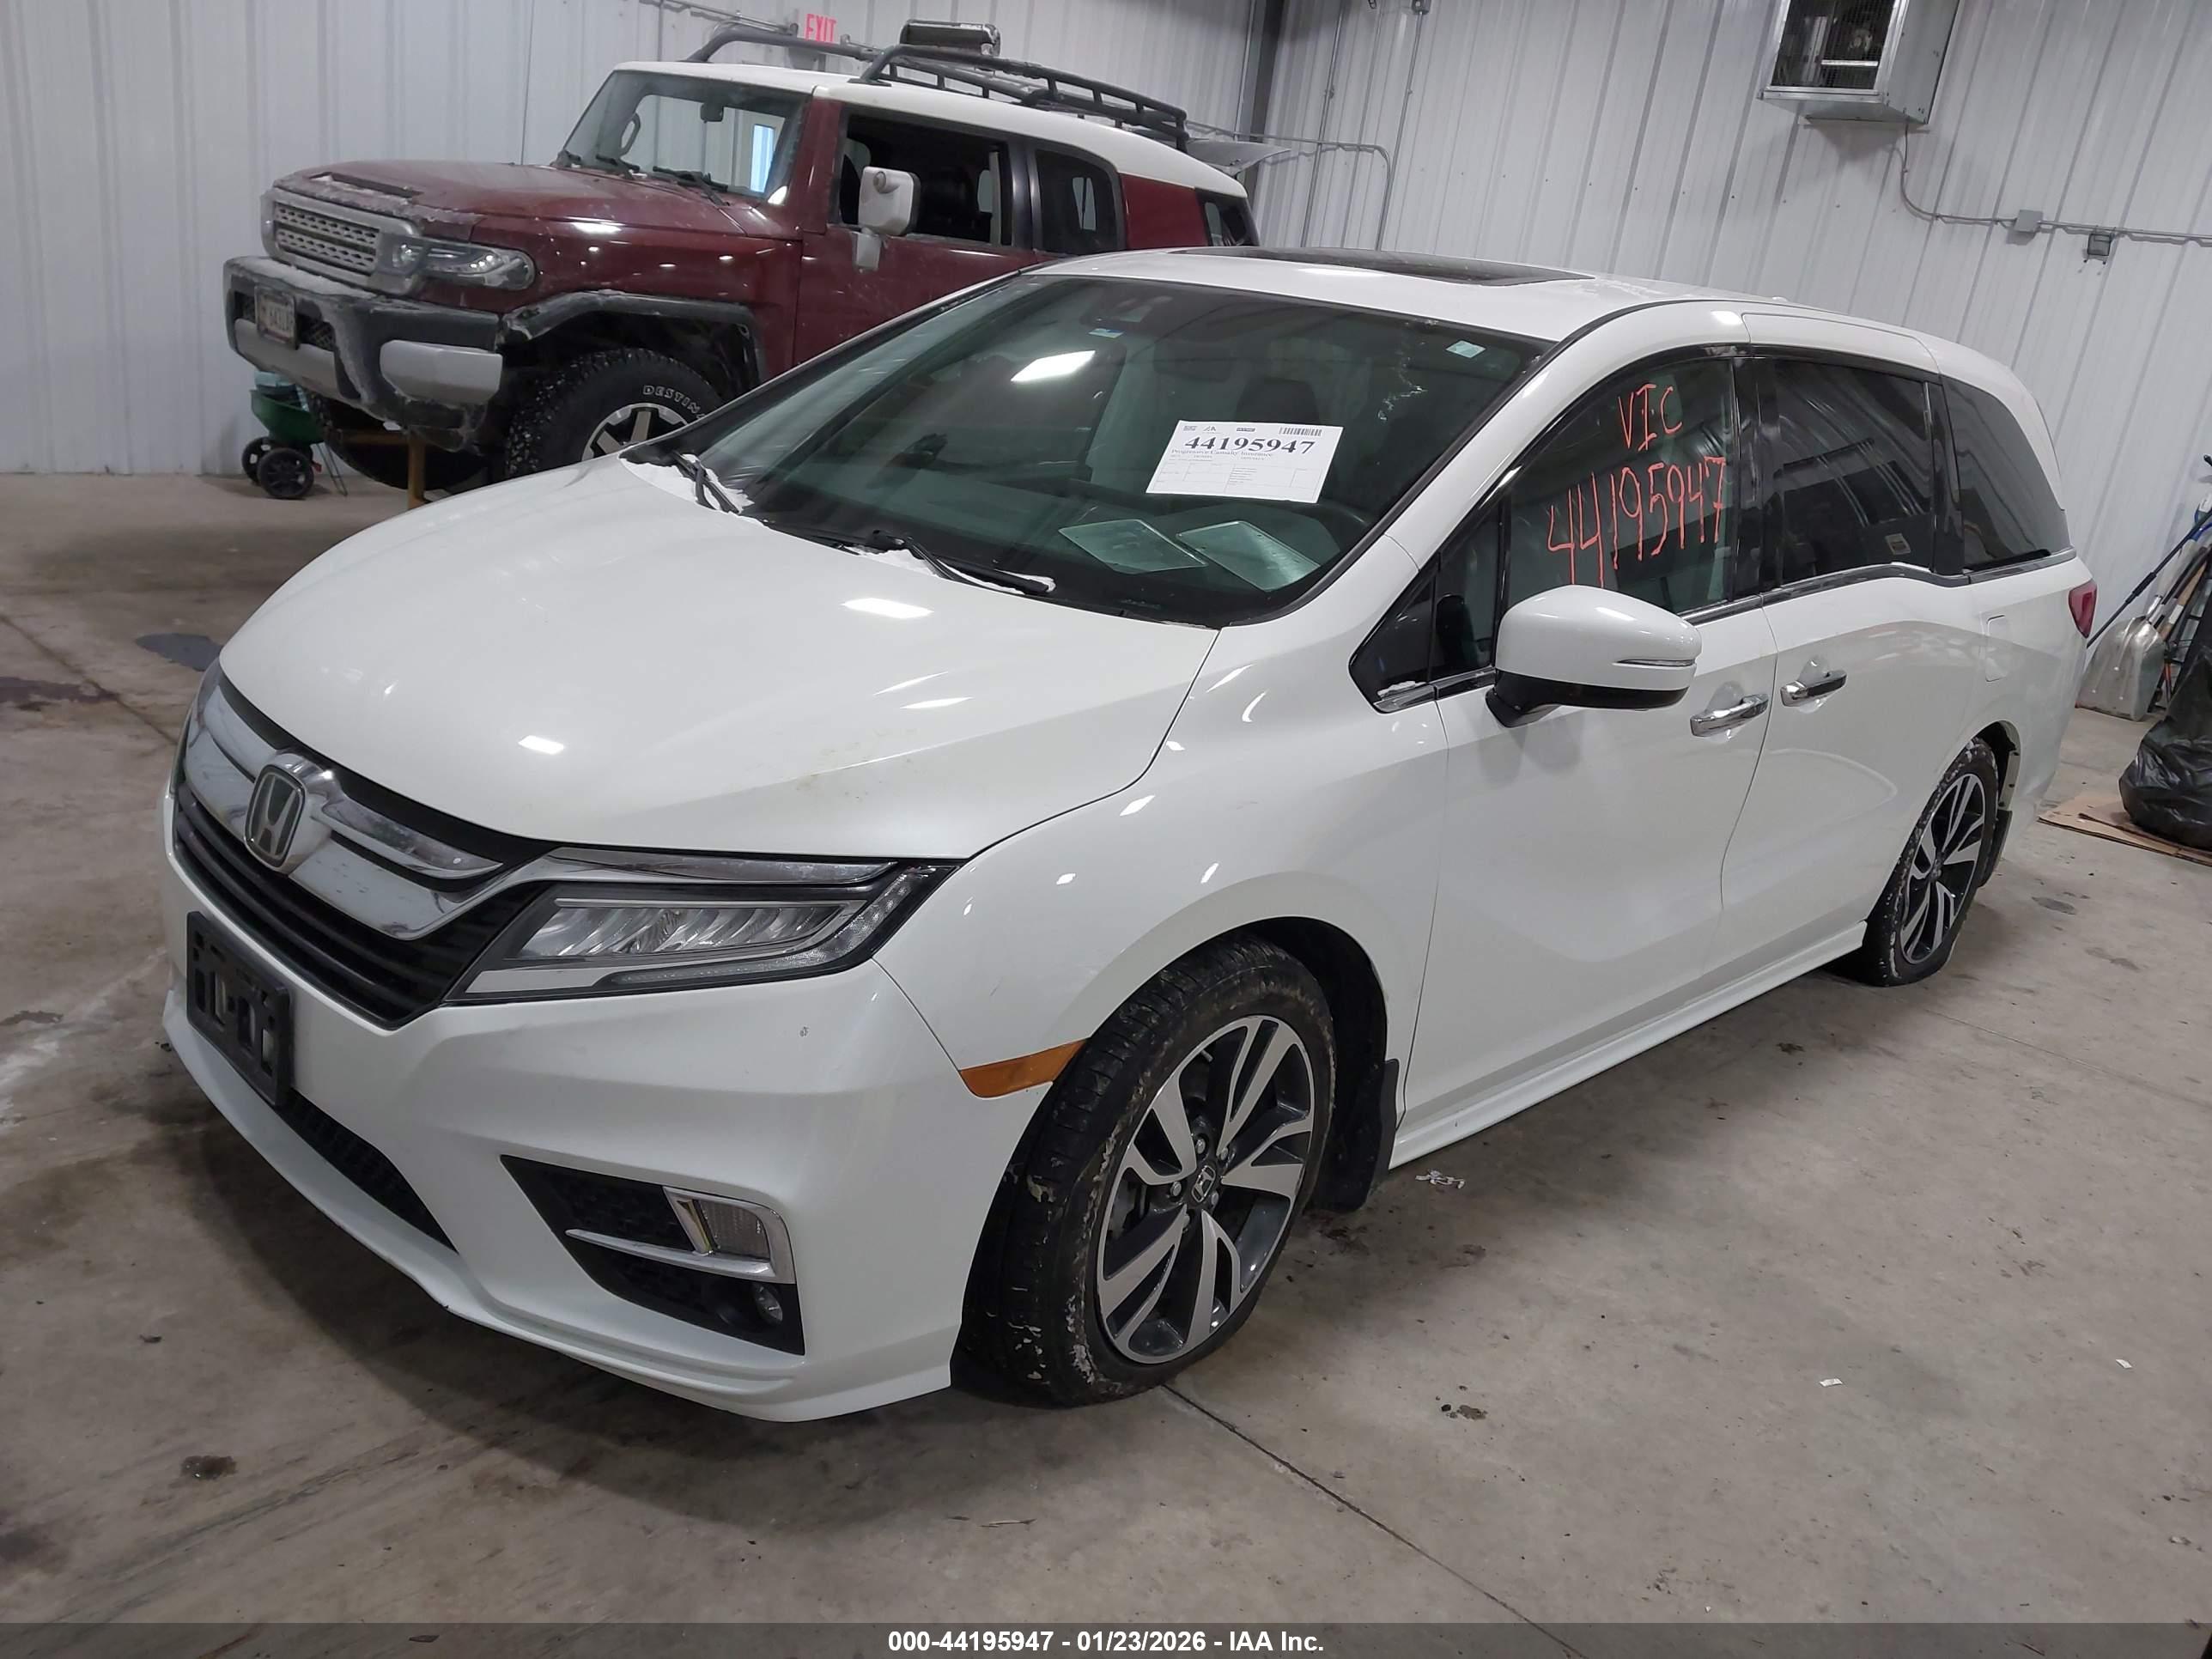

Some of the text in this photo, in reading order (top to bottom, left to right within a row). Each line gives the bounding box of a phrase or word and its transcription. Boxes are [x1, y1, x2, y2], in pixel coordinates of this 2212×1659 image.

[805, 13, 837, 42] EXIT
[1618, 384, 1683, 452] VIC
[1184, 436, 1316, 454] 44195947
[1547, 455, 1726, 588] 44195947
